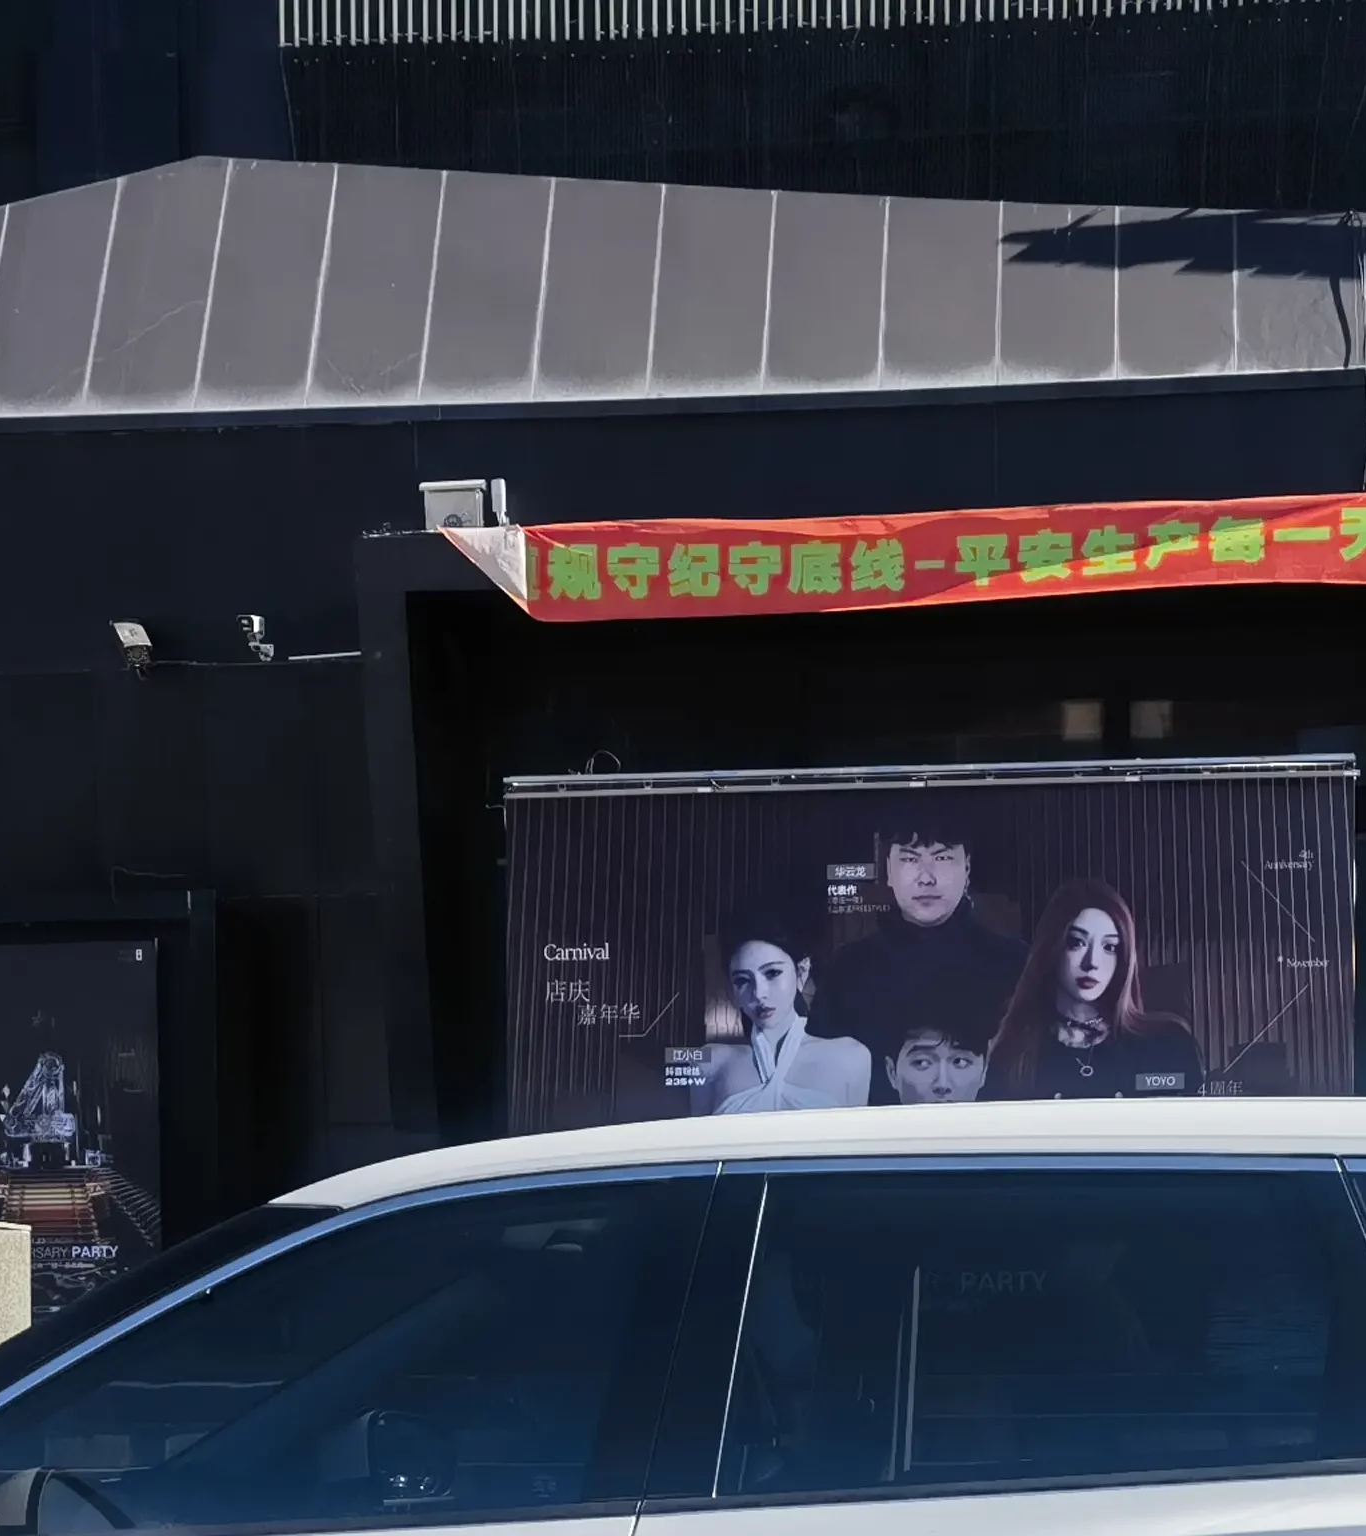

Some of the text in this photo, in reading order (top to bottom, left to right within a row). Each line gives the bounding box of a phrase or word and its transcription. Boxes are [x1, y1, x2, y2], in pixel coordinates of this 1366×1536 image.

[543, 942, 610, 961] Carnival
[545, 979, 591, 1003] 店庆
[577, 1002, 641, 1026] 嘉年华
[1145, 1075, 1176, 1087] YOYO
[71, 1244, 119, 1258] PARTY
